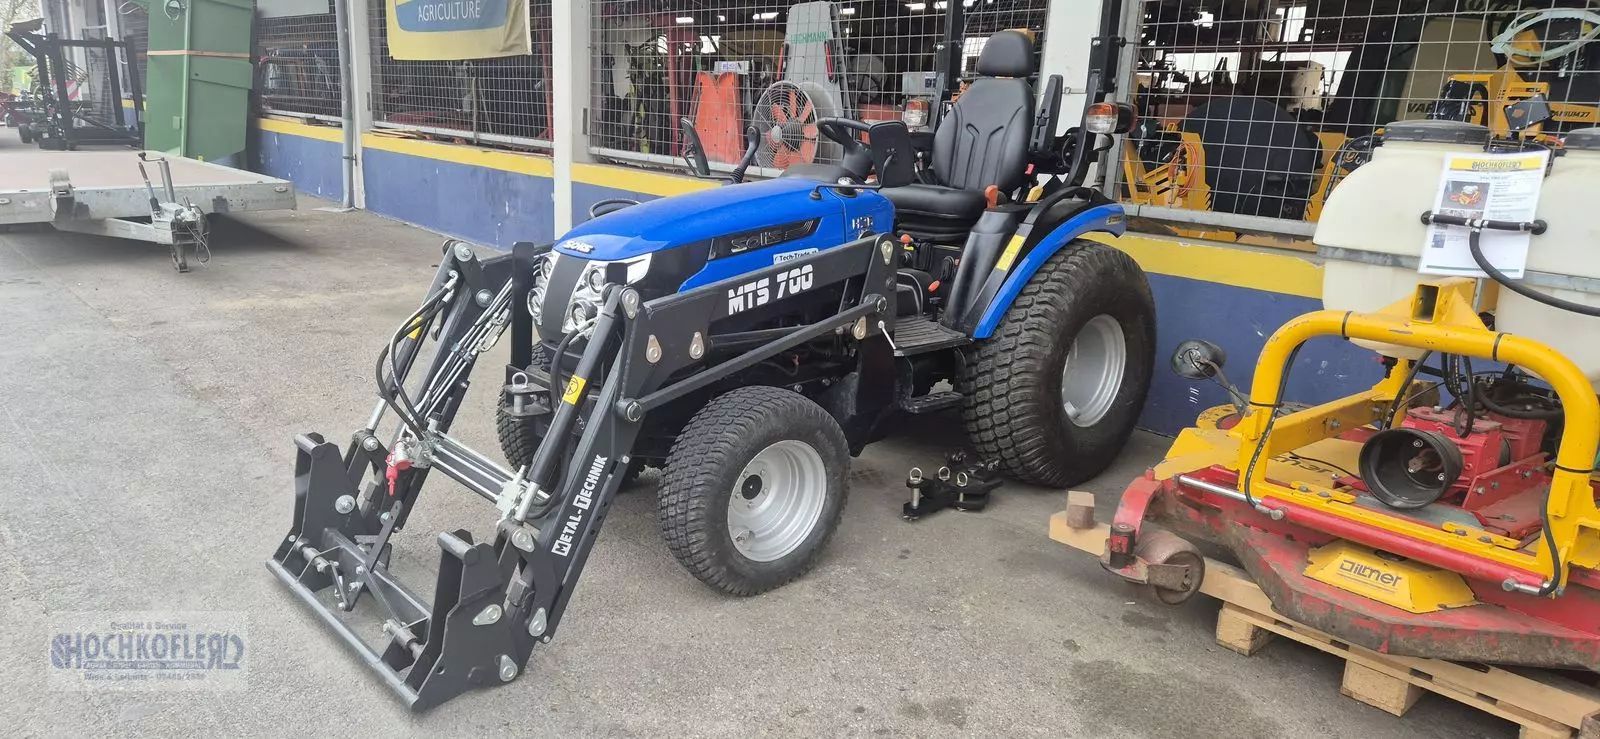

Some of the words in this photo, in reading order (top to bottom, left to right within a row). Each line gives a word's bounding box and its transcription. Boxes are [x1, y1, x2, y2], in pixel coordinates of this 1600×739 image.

[418, 1, 480, 22] AGRICULTURE
[728, 277, 769, 315] MTS
[777, 264, 813, 299] 700
